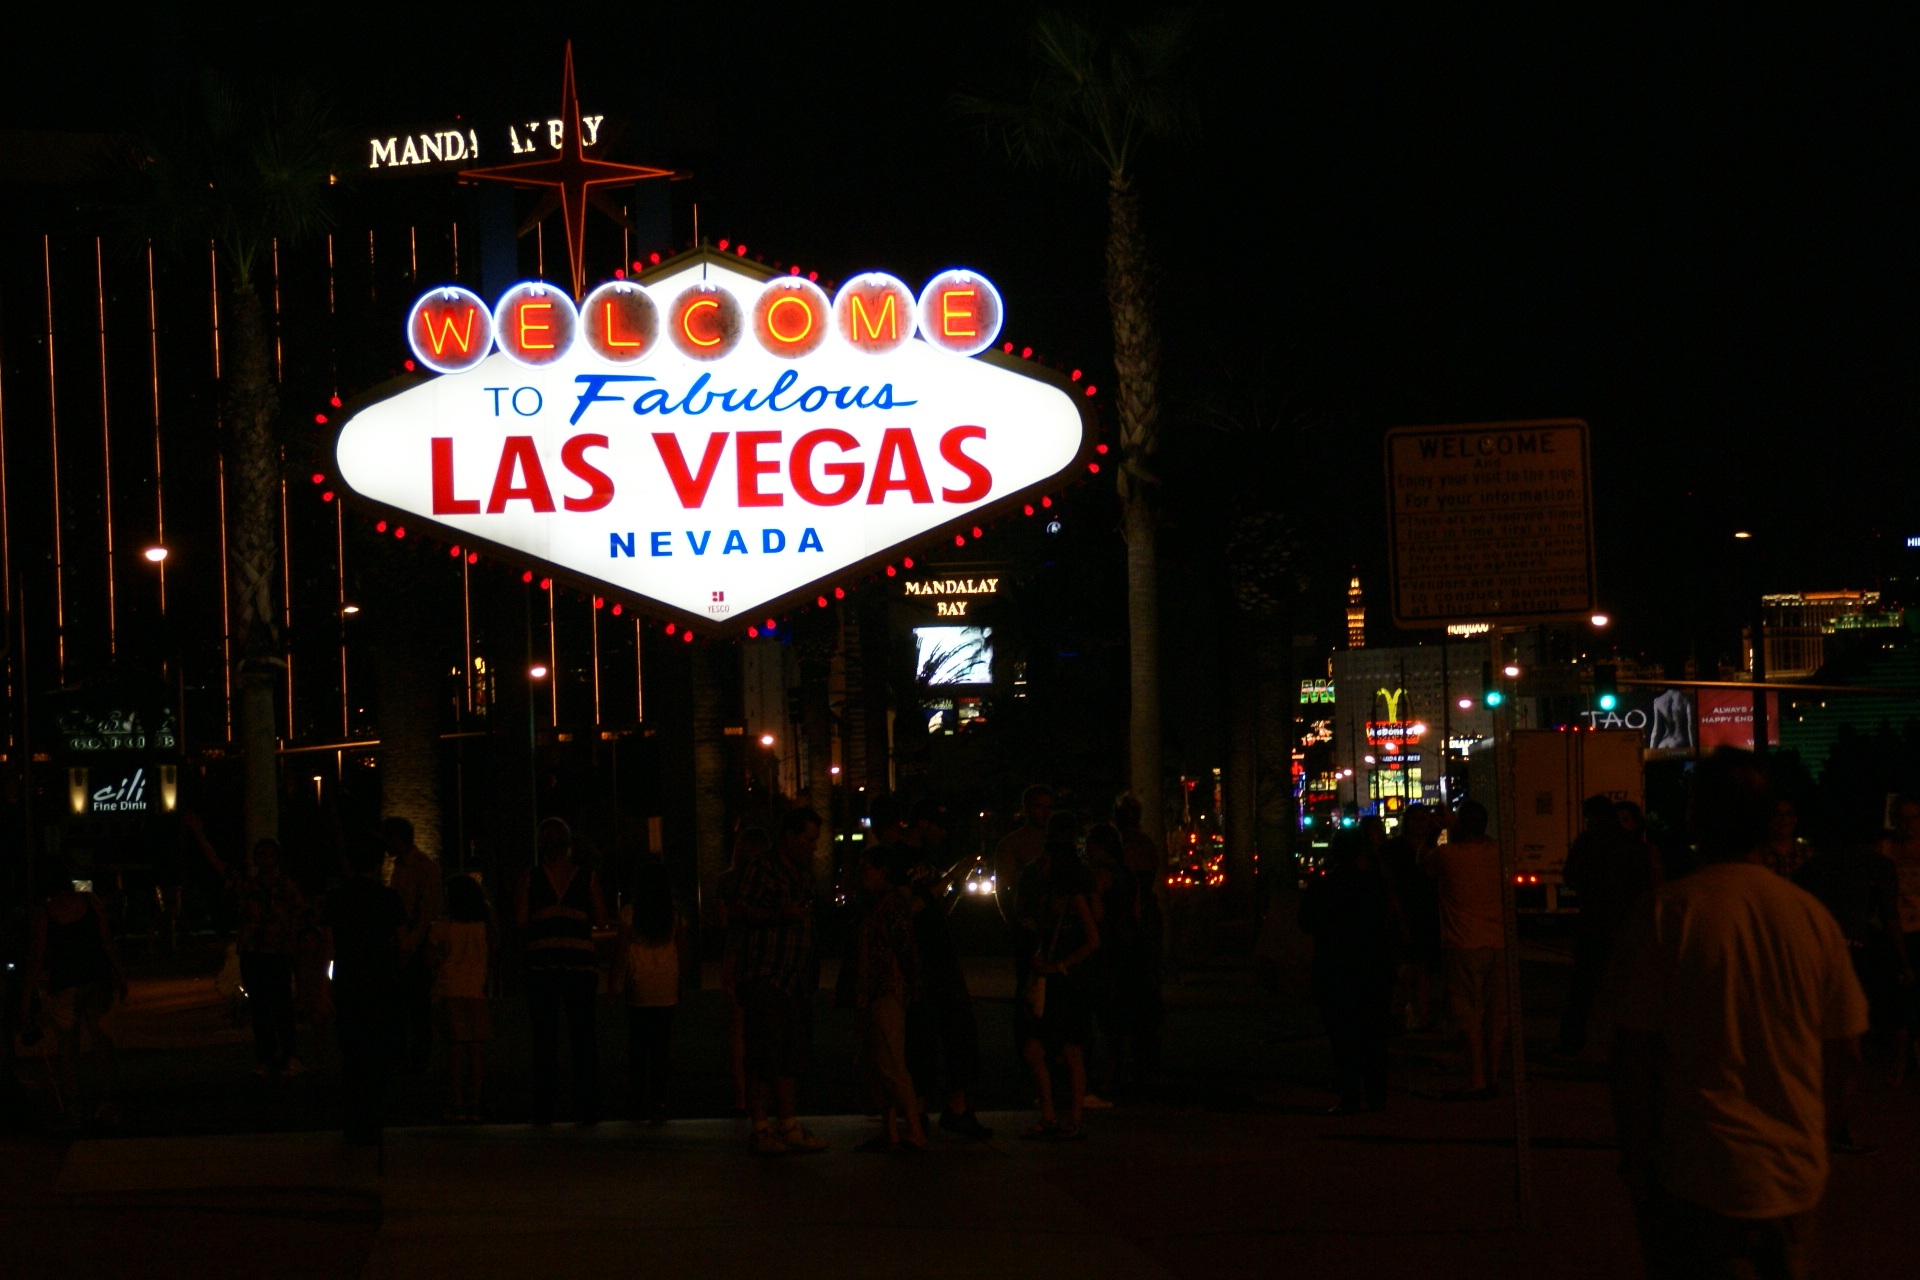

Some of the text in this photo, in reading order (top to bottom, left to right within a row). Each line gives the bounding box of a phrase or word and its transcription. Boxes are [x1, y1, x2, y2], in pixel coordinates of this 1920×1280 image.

[422, 289, 977, 357] WELCOME
[483, 368, 918, 427] TO Fabulous
[1418, 432, 1555, 460] WELCOME
[430, 424, 994, 516] LAS VEGAS
[1439, 473, 1467, 489] your
[1471, 469, 1501, 485] visit
[1504, 469, 1519, 483] to
[1522, 467, 1544, 483] the
[1404, 492, 1430, 509] For
[1436, 494, 1474, 512] your
[609, 527, 825, 560] NEVADA
[904, 578, 999, 595] MANDALAY
[707, 604, 730, 613] YESCO
[937, 601, 968, 616] BAY
[1581, 708, 1647, 730] TAO
[1701, 715, 1732, 724] HAPPY
[1712, 705, 1747, 714] ALWAYS
[93, 801, 117, 812] Fine
